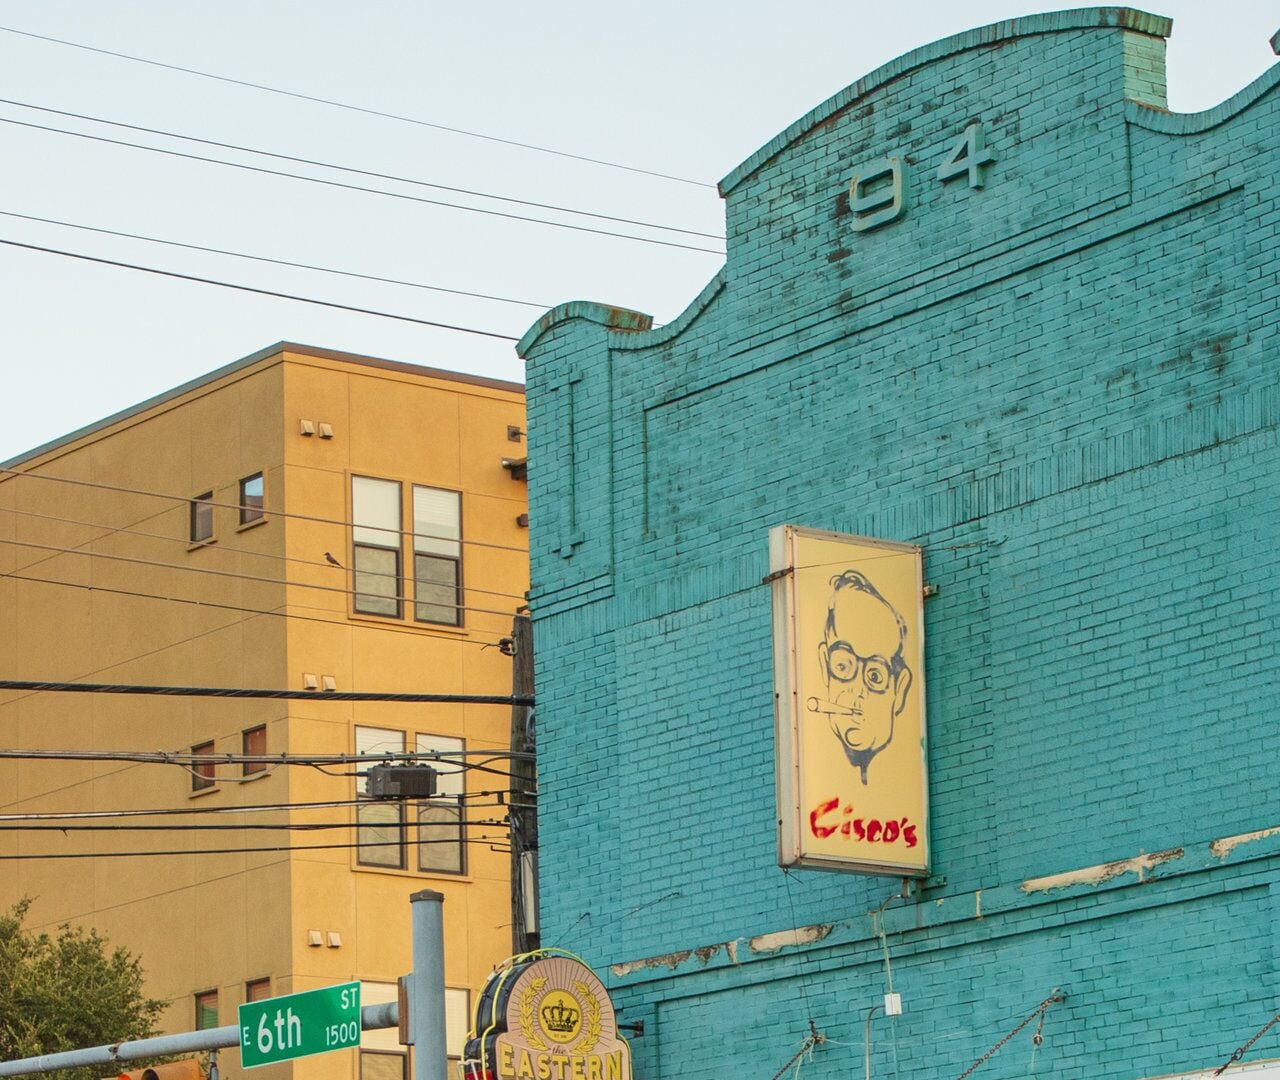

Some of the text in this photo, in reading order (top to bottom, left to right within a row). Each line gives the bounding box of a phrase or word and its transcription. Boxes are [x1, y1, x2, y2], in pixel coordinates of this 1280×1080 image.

[809, 797, 918, 848] Cisco's
[242, 987, 358, 1054] E 6th ST
[325, 1021, 358, 1046] 1500
